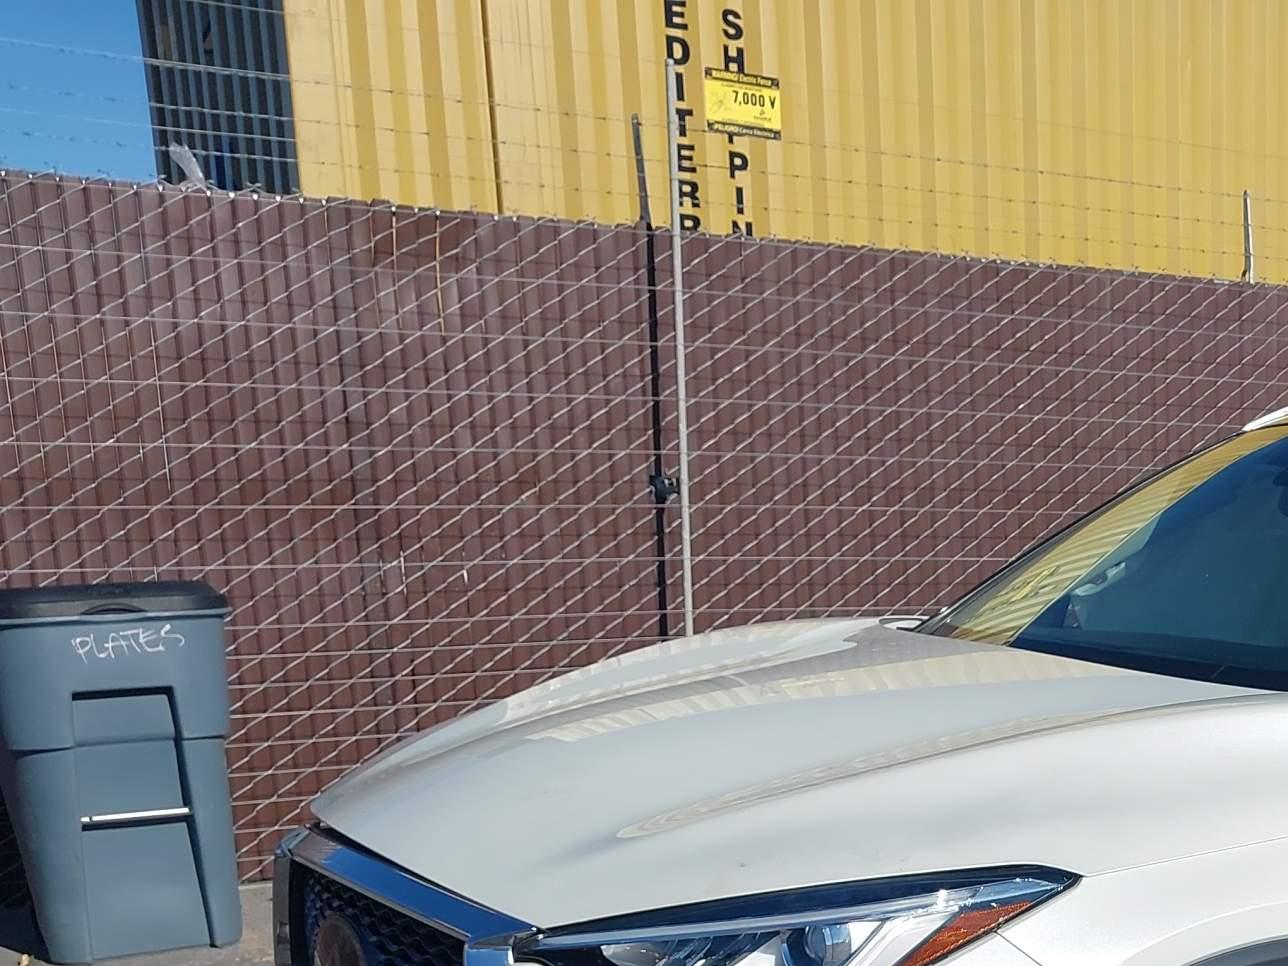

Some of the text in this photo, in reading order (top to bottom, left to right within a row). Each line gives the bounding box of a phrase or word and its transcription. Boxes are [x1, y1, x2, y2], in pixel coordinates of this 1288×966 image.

[732, 90, 776, 109] 7,000 V
[70, 623, 185, 664] PLATES
